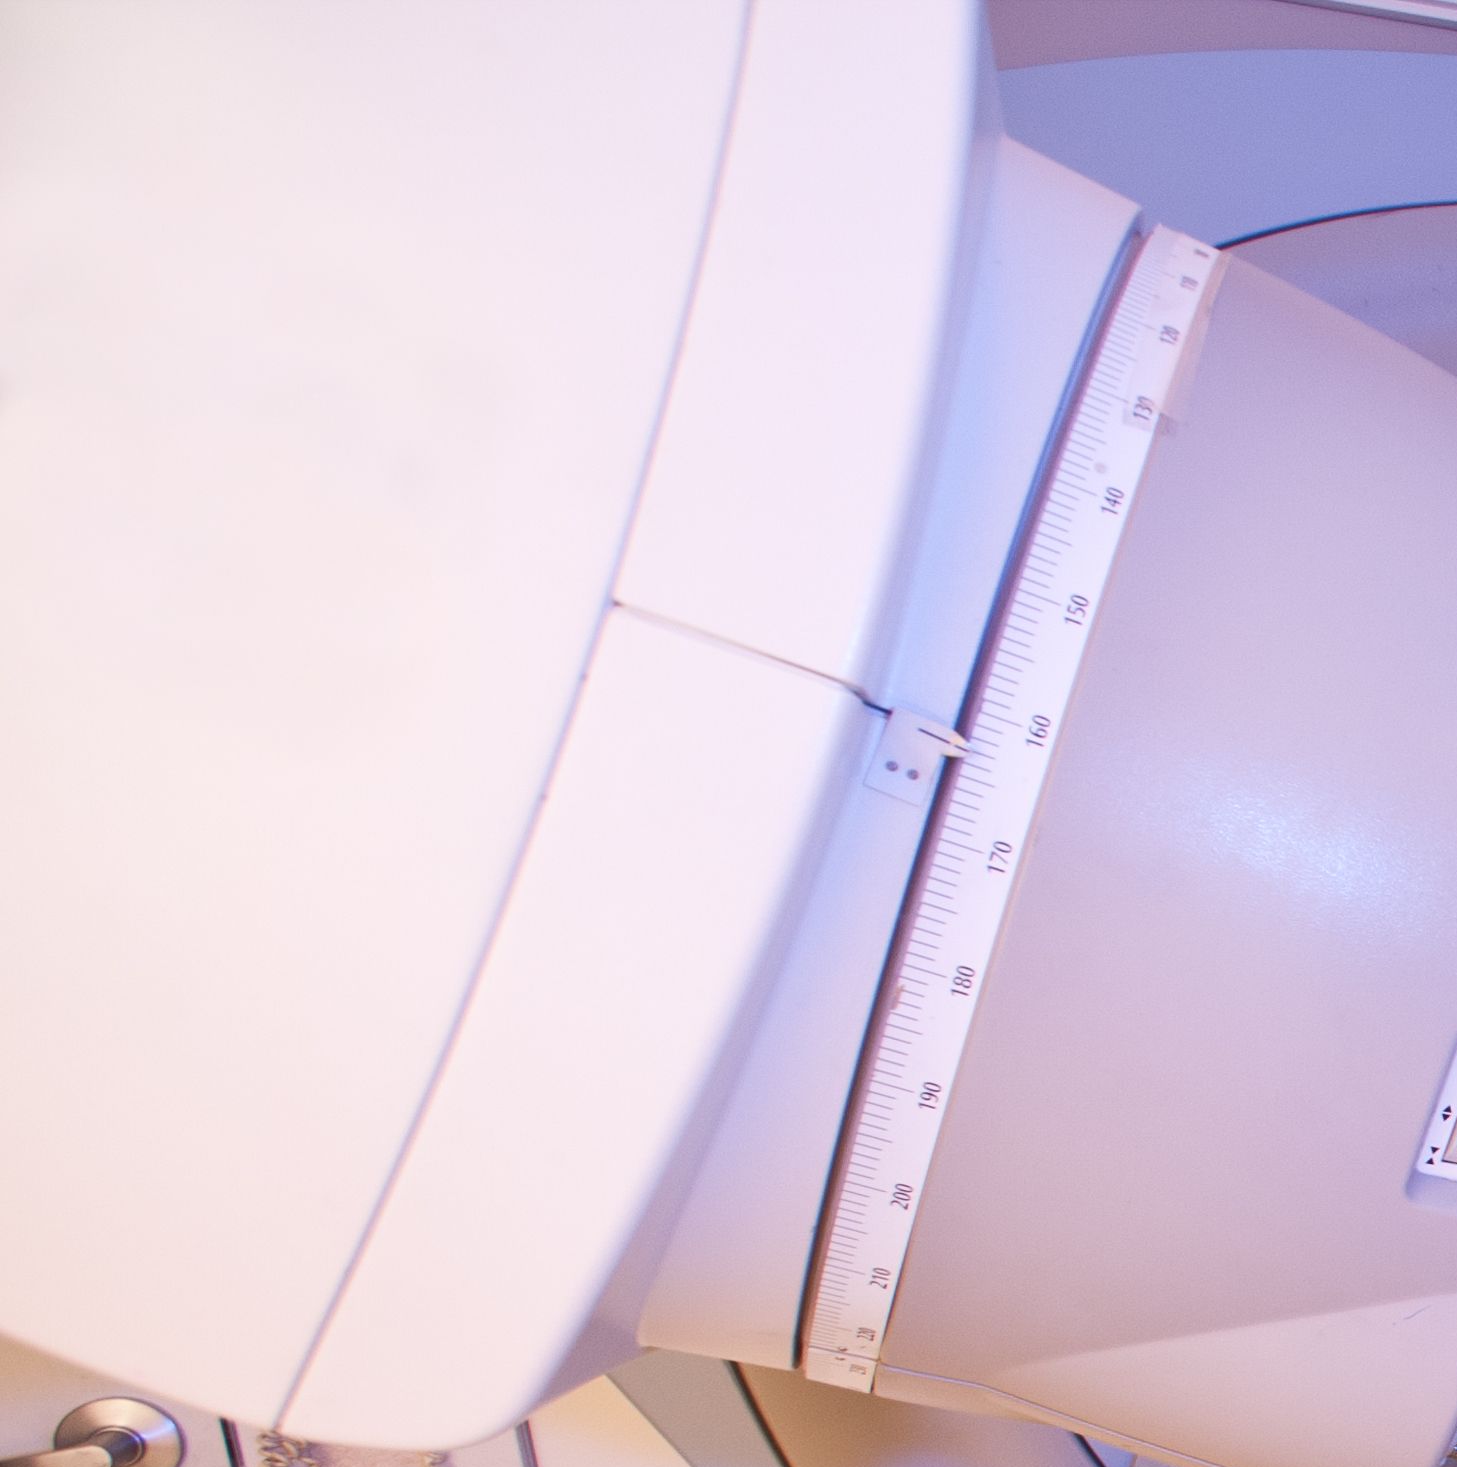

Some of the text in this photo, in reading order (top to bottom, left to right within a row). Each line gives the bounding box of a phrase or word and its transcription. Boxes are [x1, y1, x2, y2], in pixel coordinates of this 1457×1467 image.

[1160, 324, 1181, 346] 120
[1132, 395, 1155, 422] 130
[1100, 486, 1125, 516] 140
[1063, 594, 1090, 627] 150
[1025, 714, 1052, 748] 160
[986, 840, 1013, 874] 170
[950, 964, 976, 998] 180
[917, 1080, 943, 1111] 190
[890, 1183, 914, 1211] 200
[870, 1267, 892, 1290] 210
